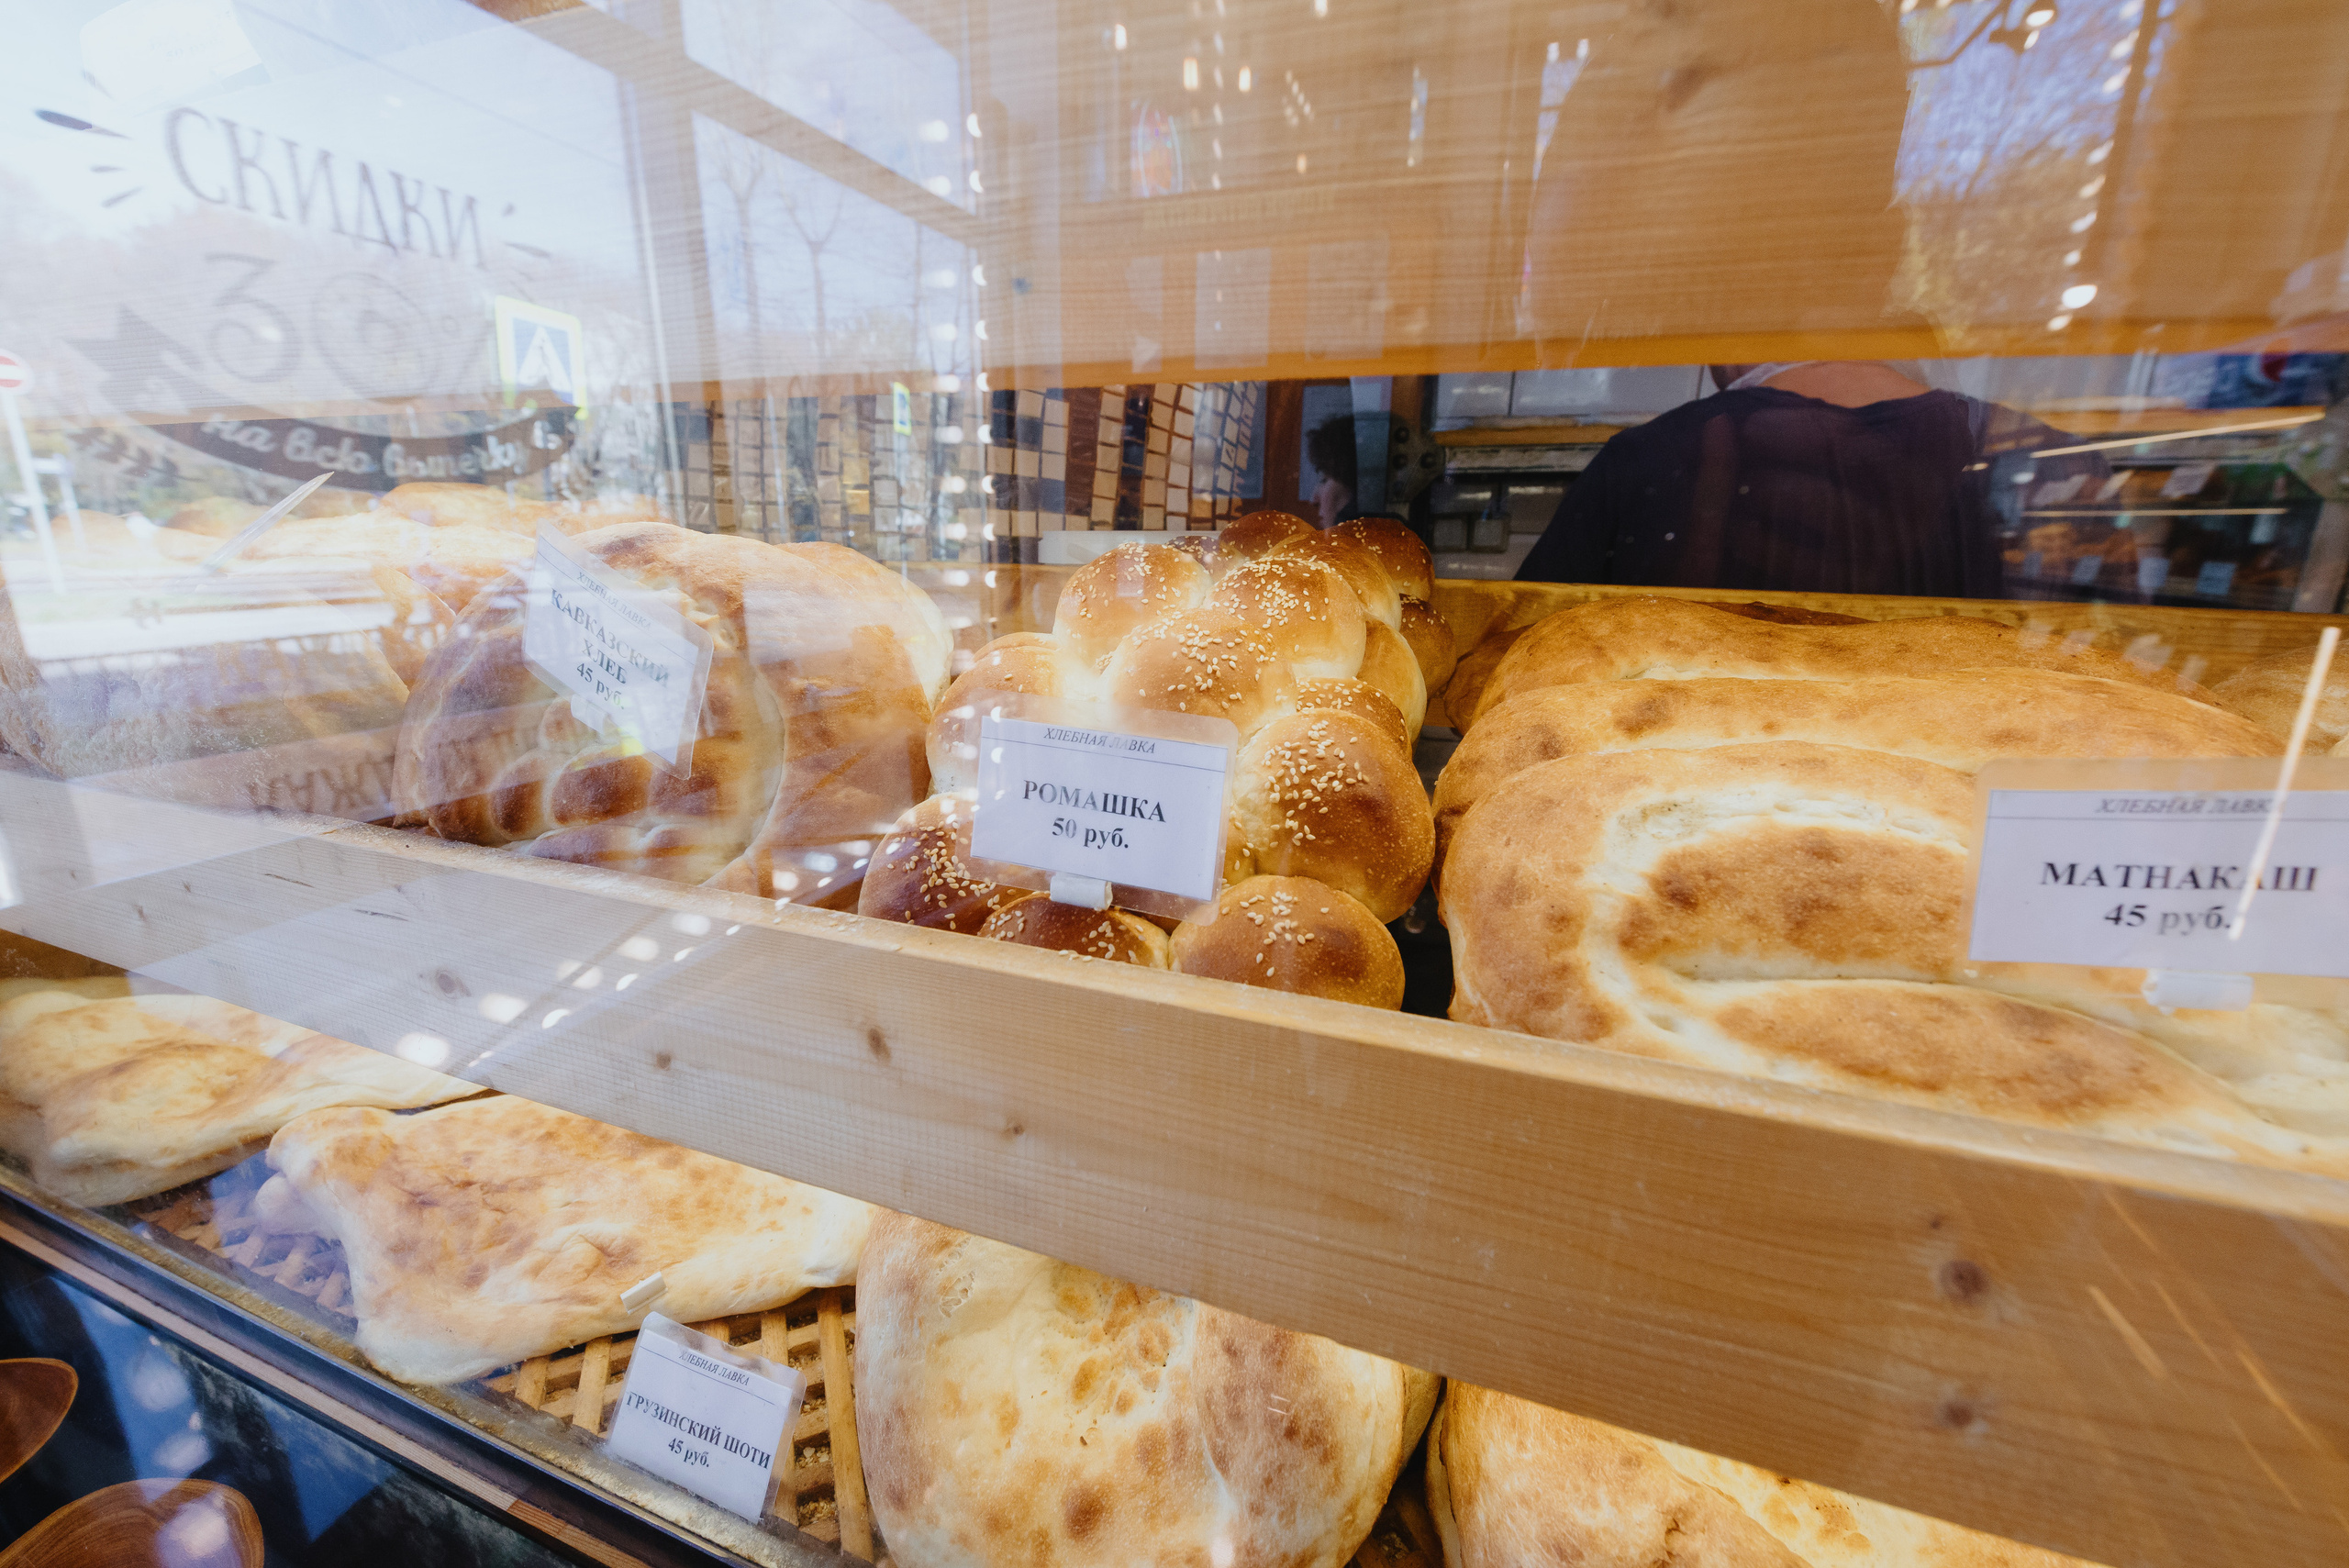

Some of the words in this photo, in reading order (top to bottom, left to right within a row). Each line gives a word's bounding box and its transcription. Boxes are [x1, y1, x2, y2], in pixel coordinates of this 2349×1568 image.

[165, 106, 488, 271] СКИДКИ
[284, 426, 378, 475] всю
[577, 572, 618, 609] ХЛЕБНАЯ
[618, 601, 651, 631] ЛАВКА
[550, 588, 671, 687] КАВКАЗСКИЙ
[581, 639, 627, 685] ХЛЕБ
[576, 662, 594, 684] 45
[596, 676, 626, 709] руб.
[1043, 728, 1107, 748] ХЛЕБНАЯ
[1108, 735, 1156, 755] ЛАВКА
[1022, 779, 1166, 823] РОМАШКА
[2096, 797, 2207, 814] ХЛЕБНАЯ
[2208, 797, 2277, 815] ЛАВК
[1052, 817, 1077, 839] 50
[1083, 827, 1130, 850] руб.
[2103, 904, 2148, 928] 45
[2157, 905, 2232, 936] руб.
[678, 1350, 719, 1373] ХЛЕБНАЯ
[718, 1366, 750, 1386] ЛАВКА
[627, 1392, 722, 1447] ГРУЗИНСКИЙ
[723, 1434, 772, 1470] ШОТИ
[668, 1437, 683, 1454] 45
[684, 1448, 710, 1468] руб.
